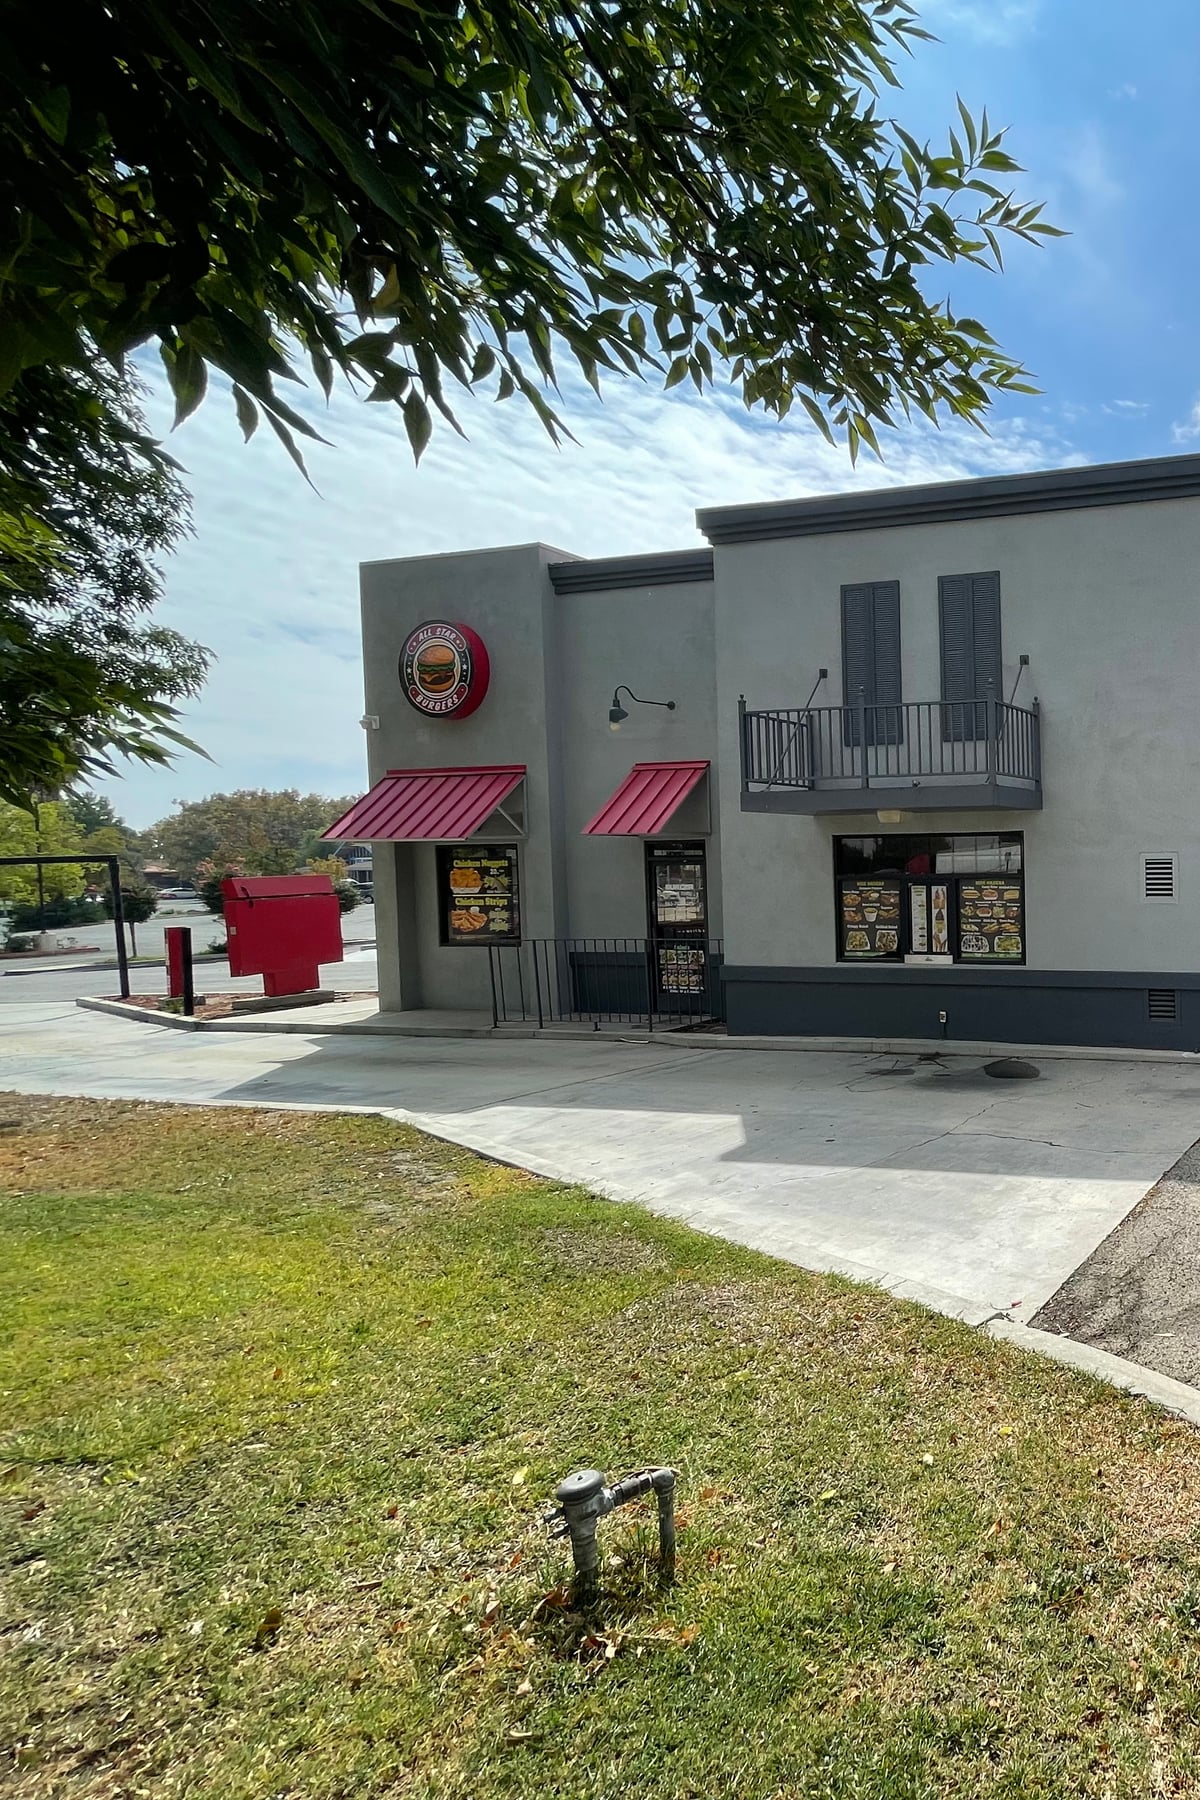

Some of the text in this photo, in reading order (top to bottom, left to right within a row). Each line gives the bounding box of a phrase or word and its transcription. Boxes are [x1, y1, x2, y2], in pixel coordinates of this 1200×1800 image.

[418, 627, 457, 642] ALL STAR
[415, 694, 459, 711] BURGERS
